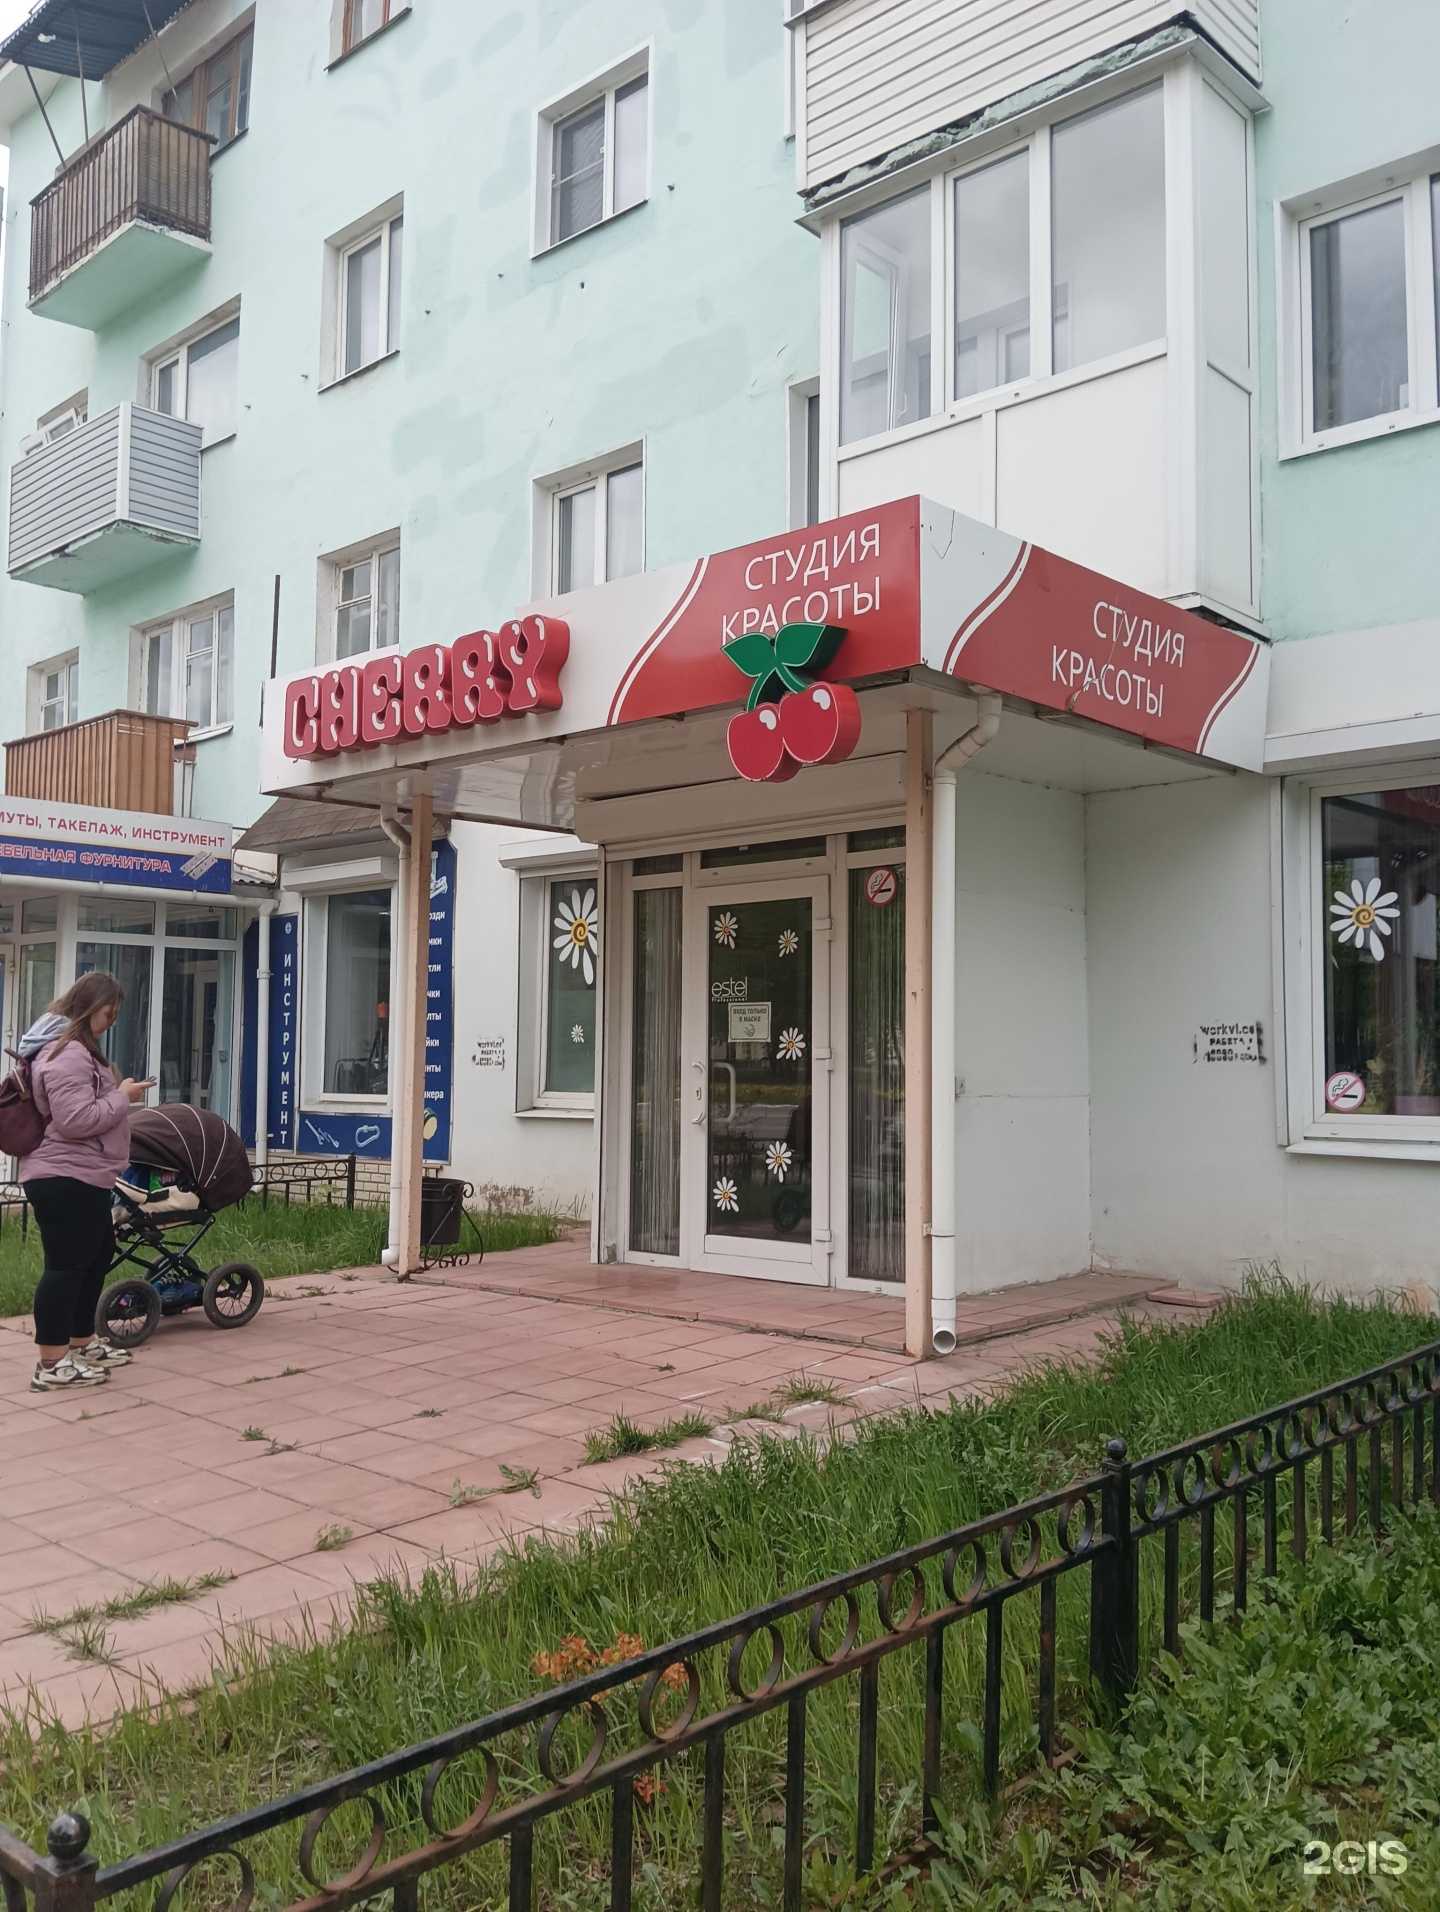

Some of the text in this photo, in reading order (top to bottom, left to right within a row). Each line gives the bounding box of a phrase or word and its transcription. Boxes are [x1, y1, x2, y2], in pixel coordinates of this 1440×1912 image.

[744, 523, 880, 591] СТУДИЯ
[721, 576, 880, 647] КРАСОТЫ
[1093, 601, 1185, 668] СТУДИЯ
[283, 613, 570, 762] CHERRY
[1051, 645, 1164, 717] КРАСОТЫ
[48, 817, 127, 839] ТАКЕЛАЖ,
[132, 827, 225, 847] ИНСТРУМЕНТ
[80, 852, 172, 873] ФУРНИТУРА
[712, 976, 747, 1000] estel
[280, 952, 292, 1146] ИНСТРУМЕНТ
